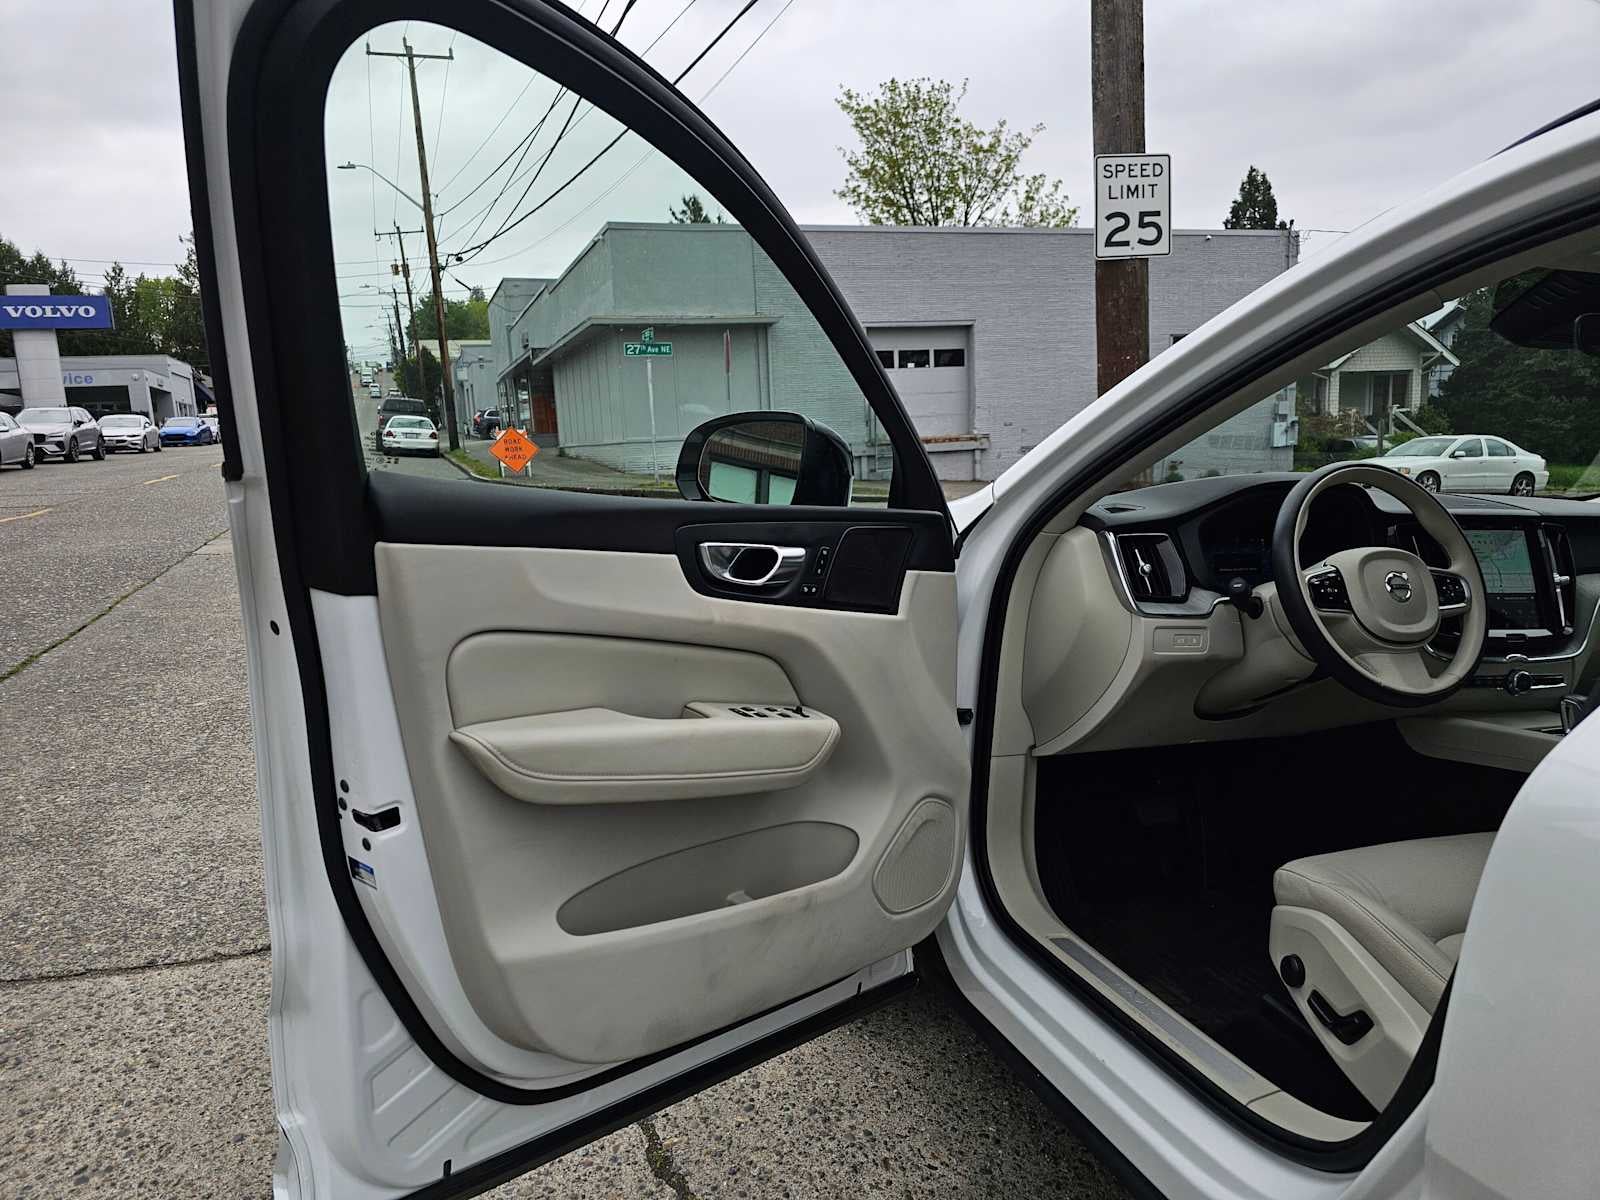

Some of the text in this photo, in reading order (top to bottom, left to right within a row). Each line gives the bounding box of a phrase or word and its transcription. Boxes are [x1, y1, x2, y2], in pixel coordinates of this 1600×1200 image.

[1103, 163, 1164, 179] SPEED
[1108, 184, 1158, 200] LIMIT
[1104, 210, 1163, 248] 25
[2, 305, 96, 318] VOLVO
[647, 345, 659, 353] Ave
[661, 345, 671, 353] NE
[504, 453, 527, 461] AHEAD
